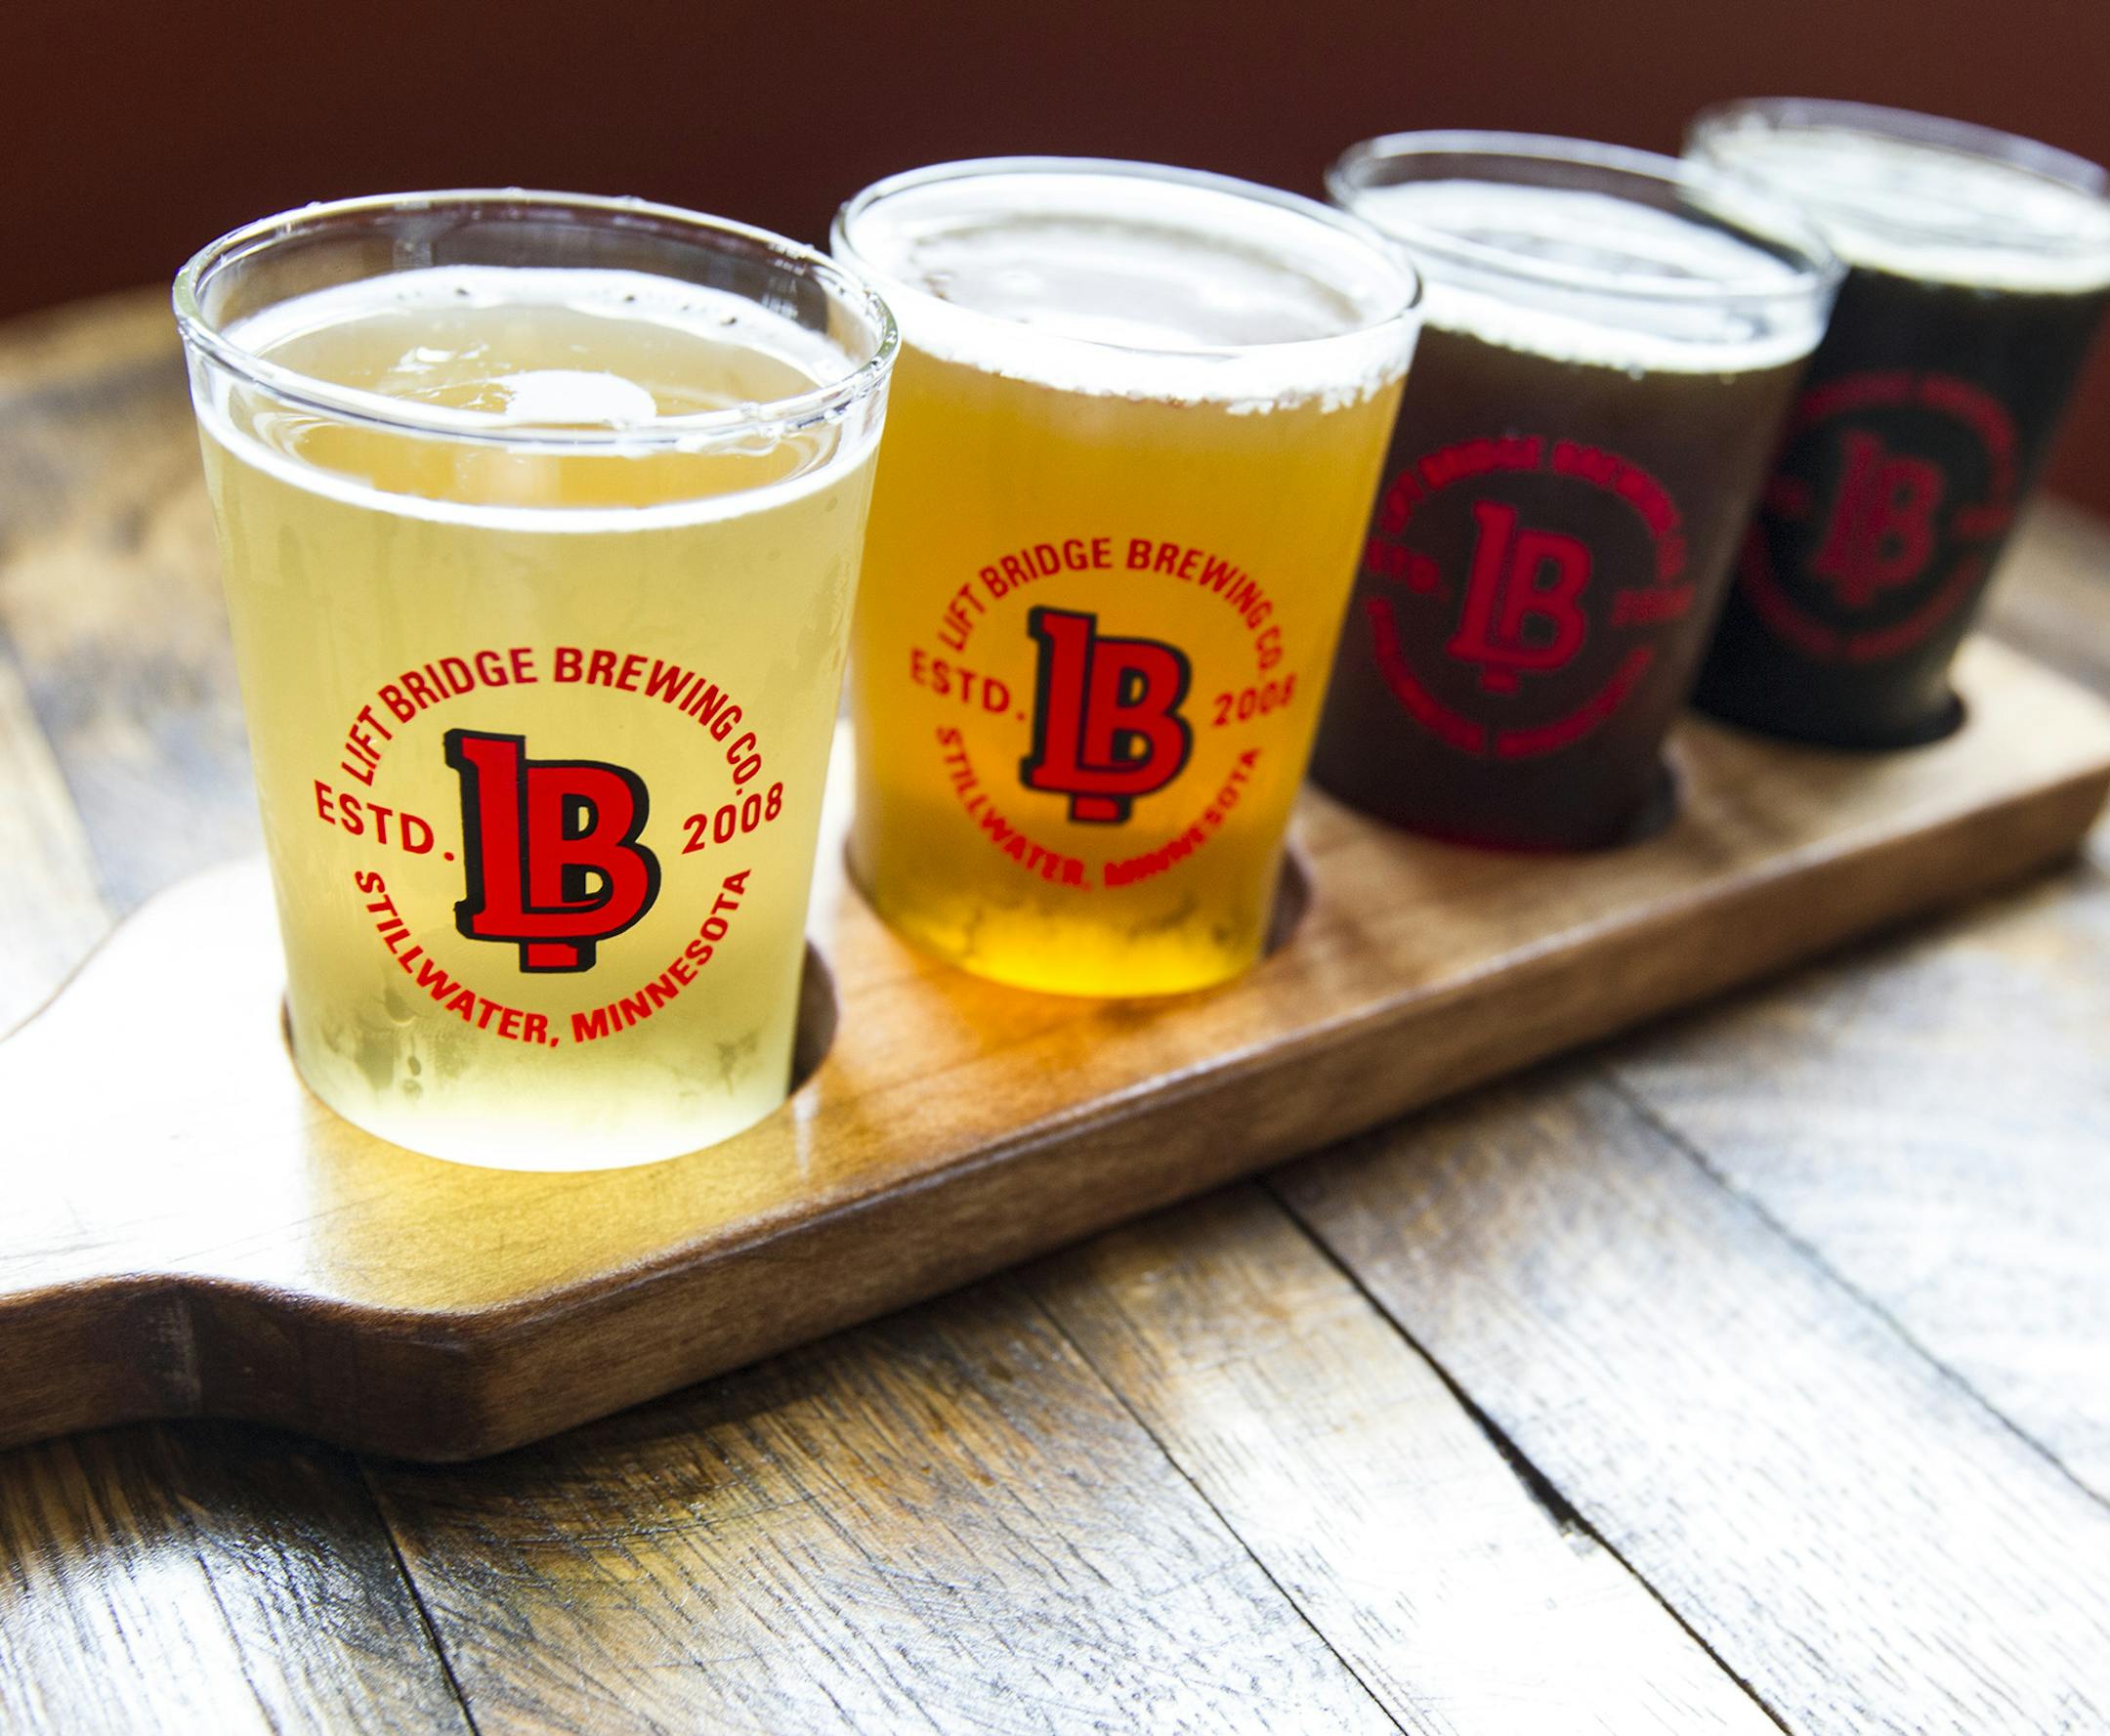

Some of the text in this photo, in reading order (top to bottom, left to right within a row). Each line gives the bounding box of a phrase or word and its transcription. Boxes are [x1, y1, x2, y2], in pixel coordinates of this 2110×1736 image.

[937, 583, 985, 653] LIFT
[980, 537, 1113, 600] BRIDGE
[1126, 538, 1273, 630] BREWING
[341, 647, 762, 795] LIFT BRIDGE BREWING CO.
[909, 647, 1026, 722] ESTD.
[314, 780, 783, 862] ESTD. 2008
[443, 728, 661, 972] LB
[355, 869, 751, 1047] STILLWATER, MINNESOTA
